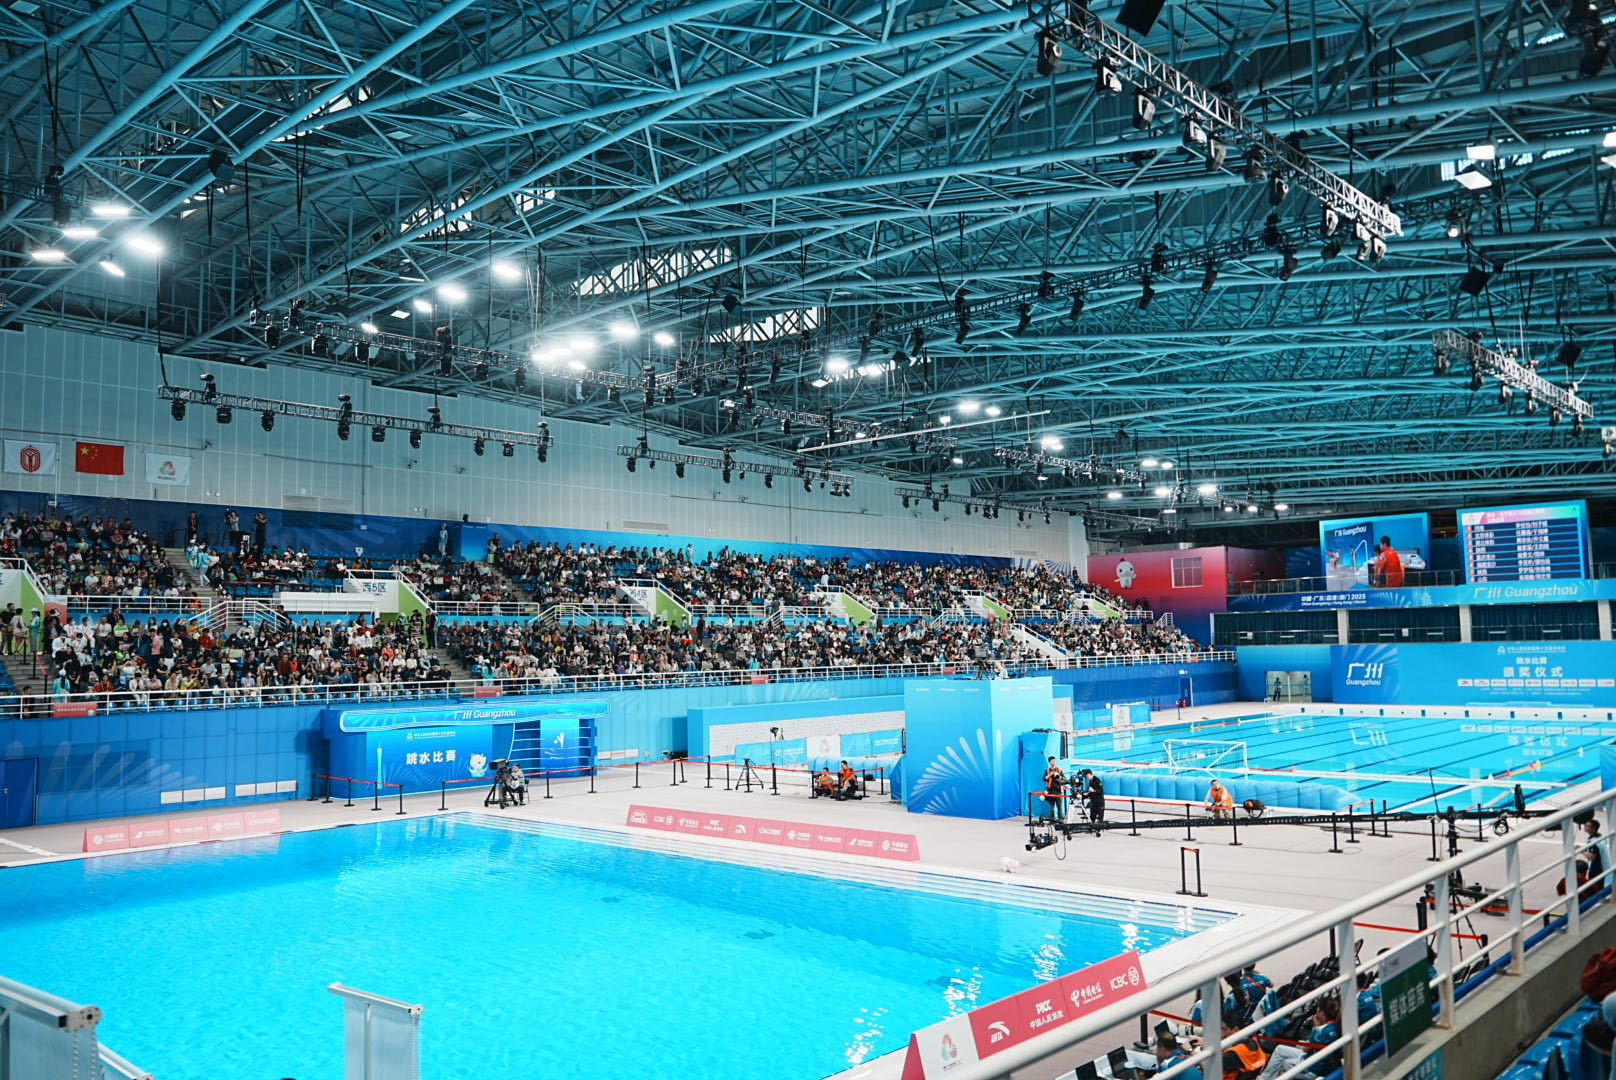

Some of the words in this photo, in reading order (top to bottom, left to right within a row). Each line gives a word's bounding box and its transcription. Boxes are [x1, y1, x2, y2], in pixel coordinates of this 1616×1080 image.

[1343, 526, 1367, 536] Guangzhou
[1504, 584, 1578, 599] Guangzhou
[1503, 666, 1563, 678] 颁奖仪式
[1346, 679, 1381, 687] Guangzhou
[473, 709, 516, 719] Guangzhou
[406, 750, 457, 765] 跳水比赛
[1110, 973, 1129, 990] ICBC
[1035, 999, 1052, 1014] PICC
